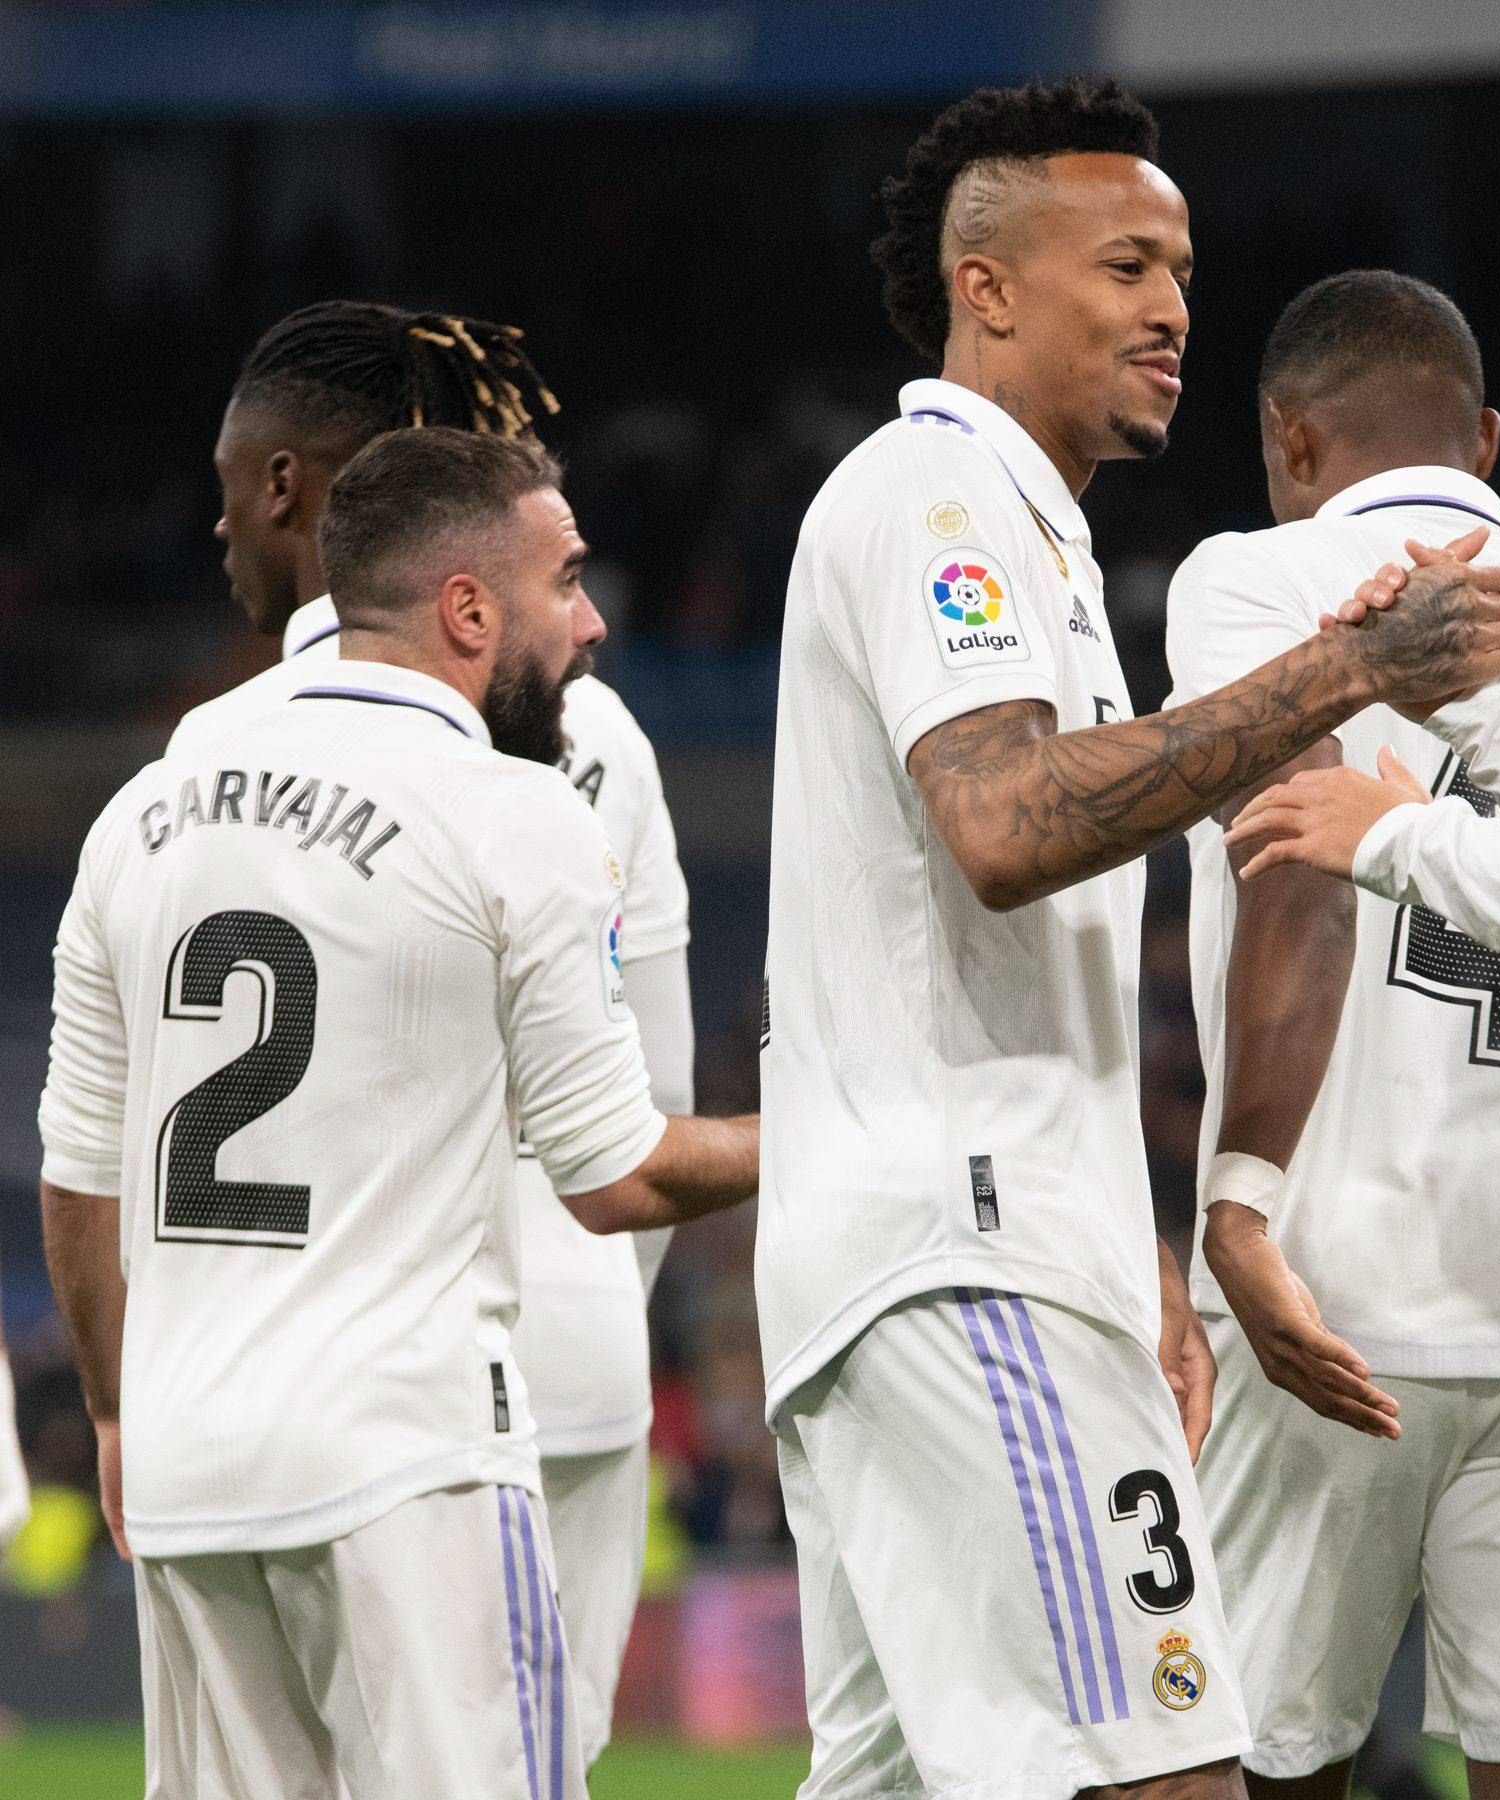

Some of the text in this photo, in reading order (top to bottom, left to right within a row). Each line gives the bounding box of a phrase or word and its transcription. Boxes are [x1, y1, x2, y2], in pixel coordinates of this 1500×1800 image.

[947, 631, 1018, 653] LaLiga
[139, 769, 402, 881] CARVAJAL
[155, 909, 318, 1250] 2
[1108, 1468, 1196, 1616] 3
